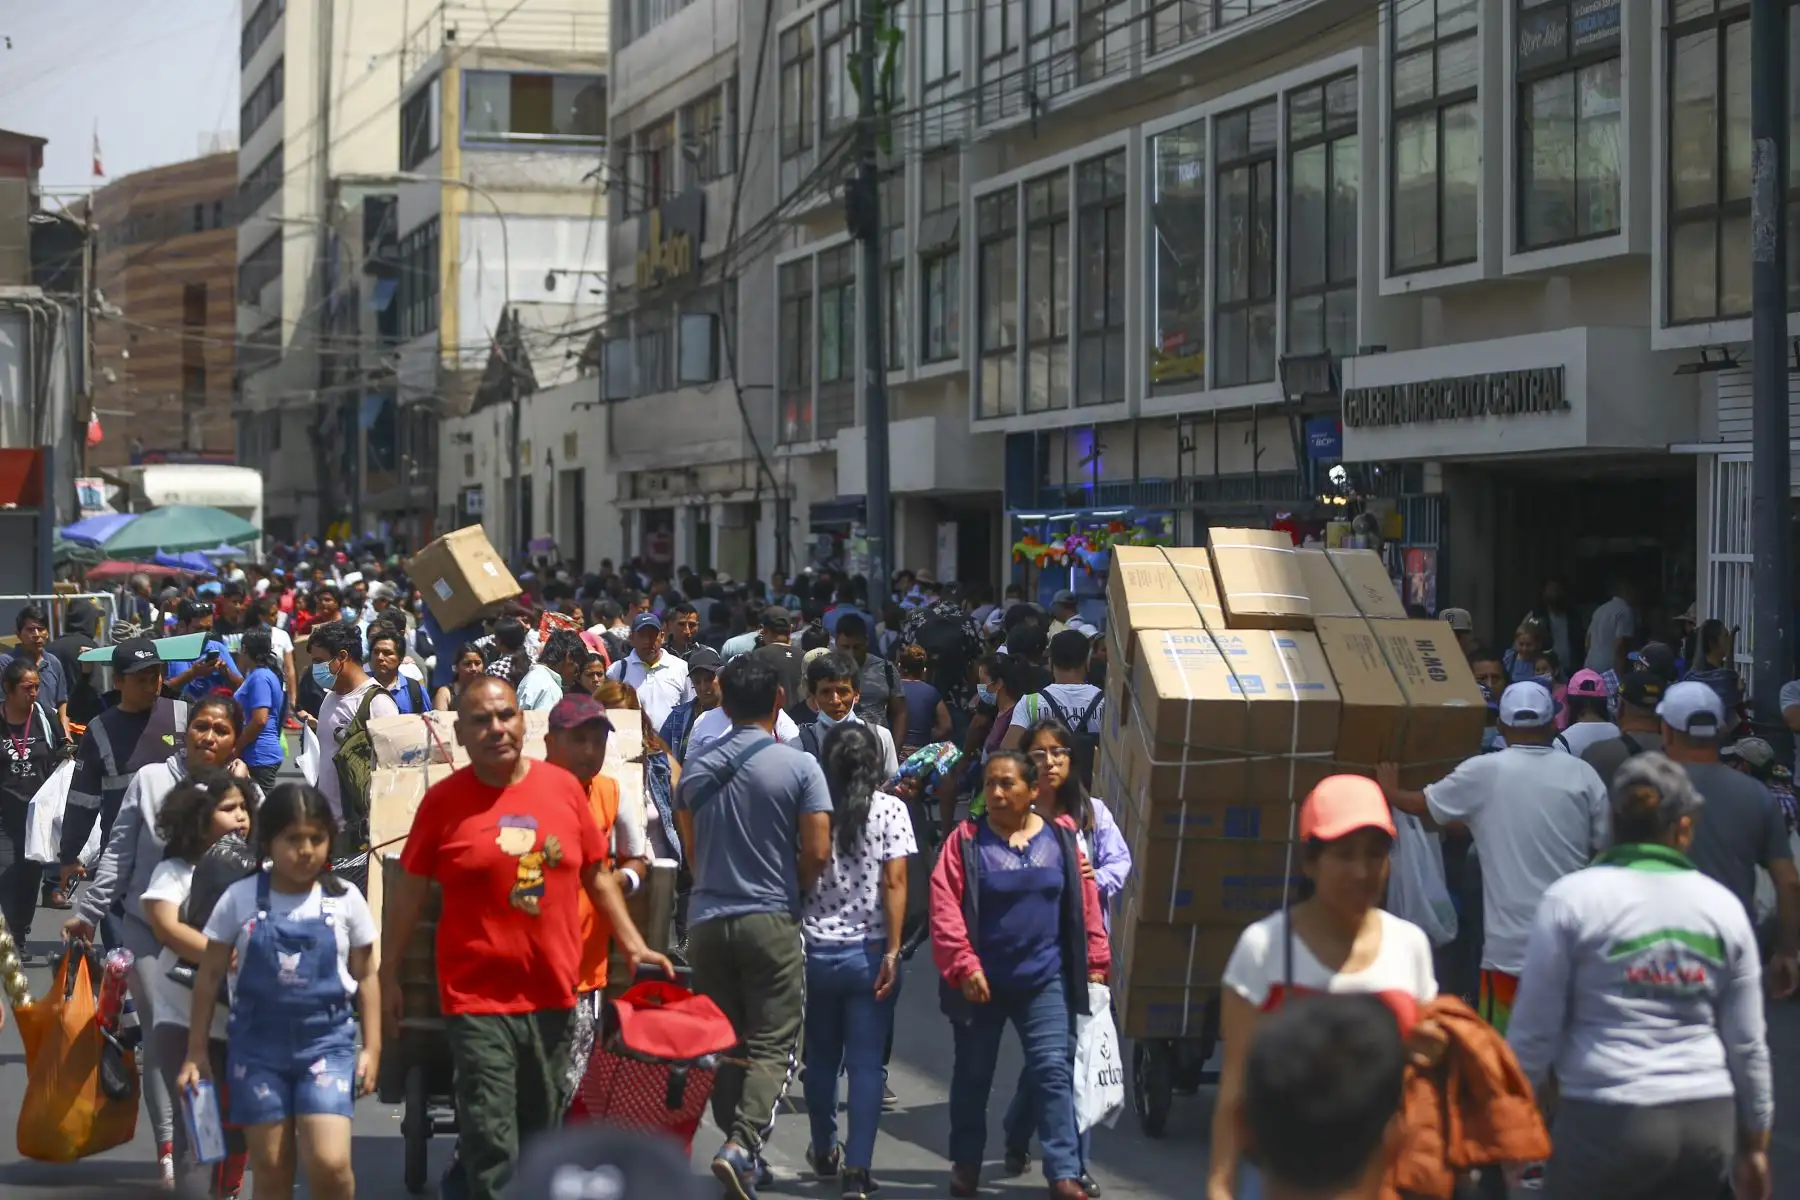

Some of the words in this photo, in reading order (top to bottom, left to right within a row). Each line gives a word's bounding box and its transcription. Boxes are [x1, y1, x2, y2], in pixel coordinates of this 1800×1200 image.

[1344, 386, 1402, 427] GALERIA
[1404, 375, 1485, 422] MERCADO
[1487, 364, 1569, 413] CENTRAL
